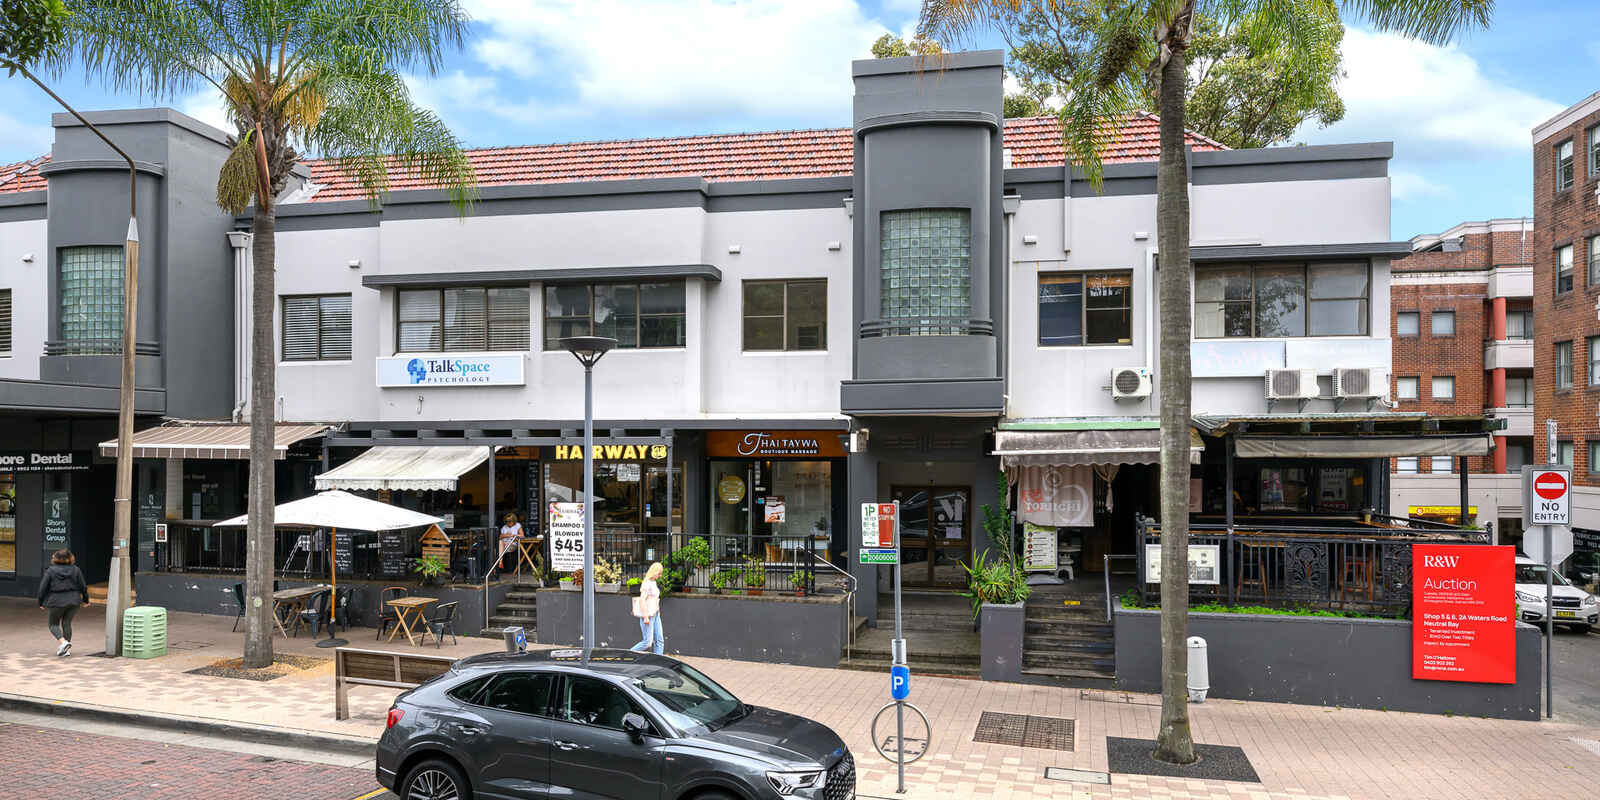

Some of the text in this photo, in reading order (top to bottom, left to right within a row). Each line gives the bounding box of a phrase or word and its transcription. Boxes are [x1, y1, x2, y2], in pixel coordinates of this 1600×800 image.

[427, 359, 490, 376] TalkSpace
[782, 440, 818, 448] TAYWA
[555, 445, 648, 460] HARWAY
[0, 453, 72, 465] ore Dental
[1541, 502, 1560, 512] NO
[1535, 512, 1566, 521] ENTRY
[45, 526, 67, 534] Dental
[46, 534, 66, 543] Group
[554, 537, 584, 552] $45
[1423, 555, 1460, 568] R&W
[1423, 577, 1477, 591] Auction
[1447, 621, 1460, 629] Bay
[893, 676, 904, 691] P
